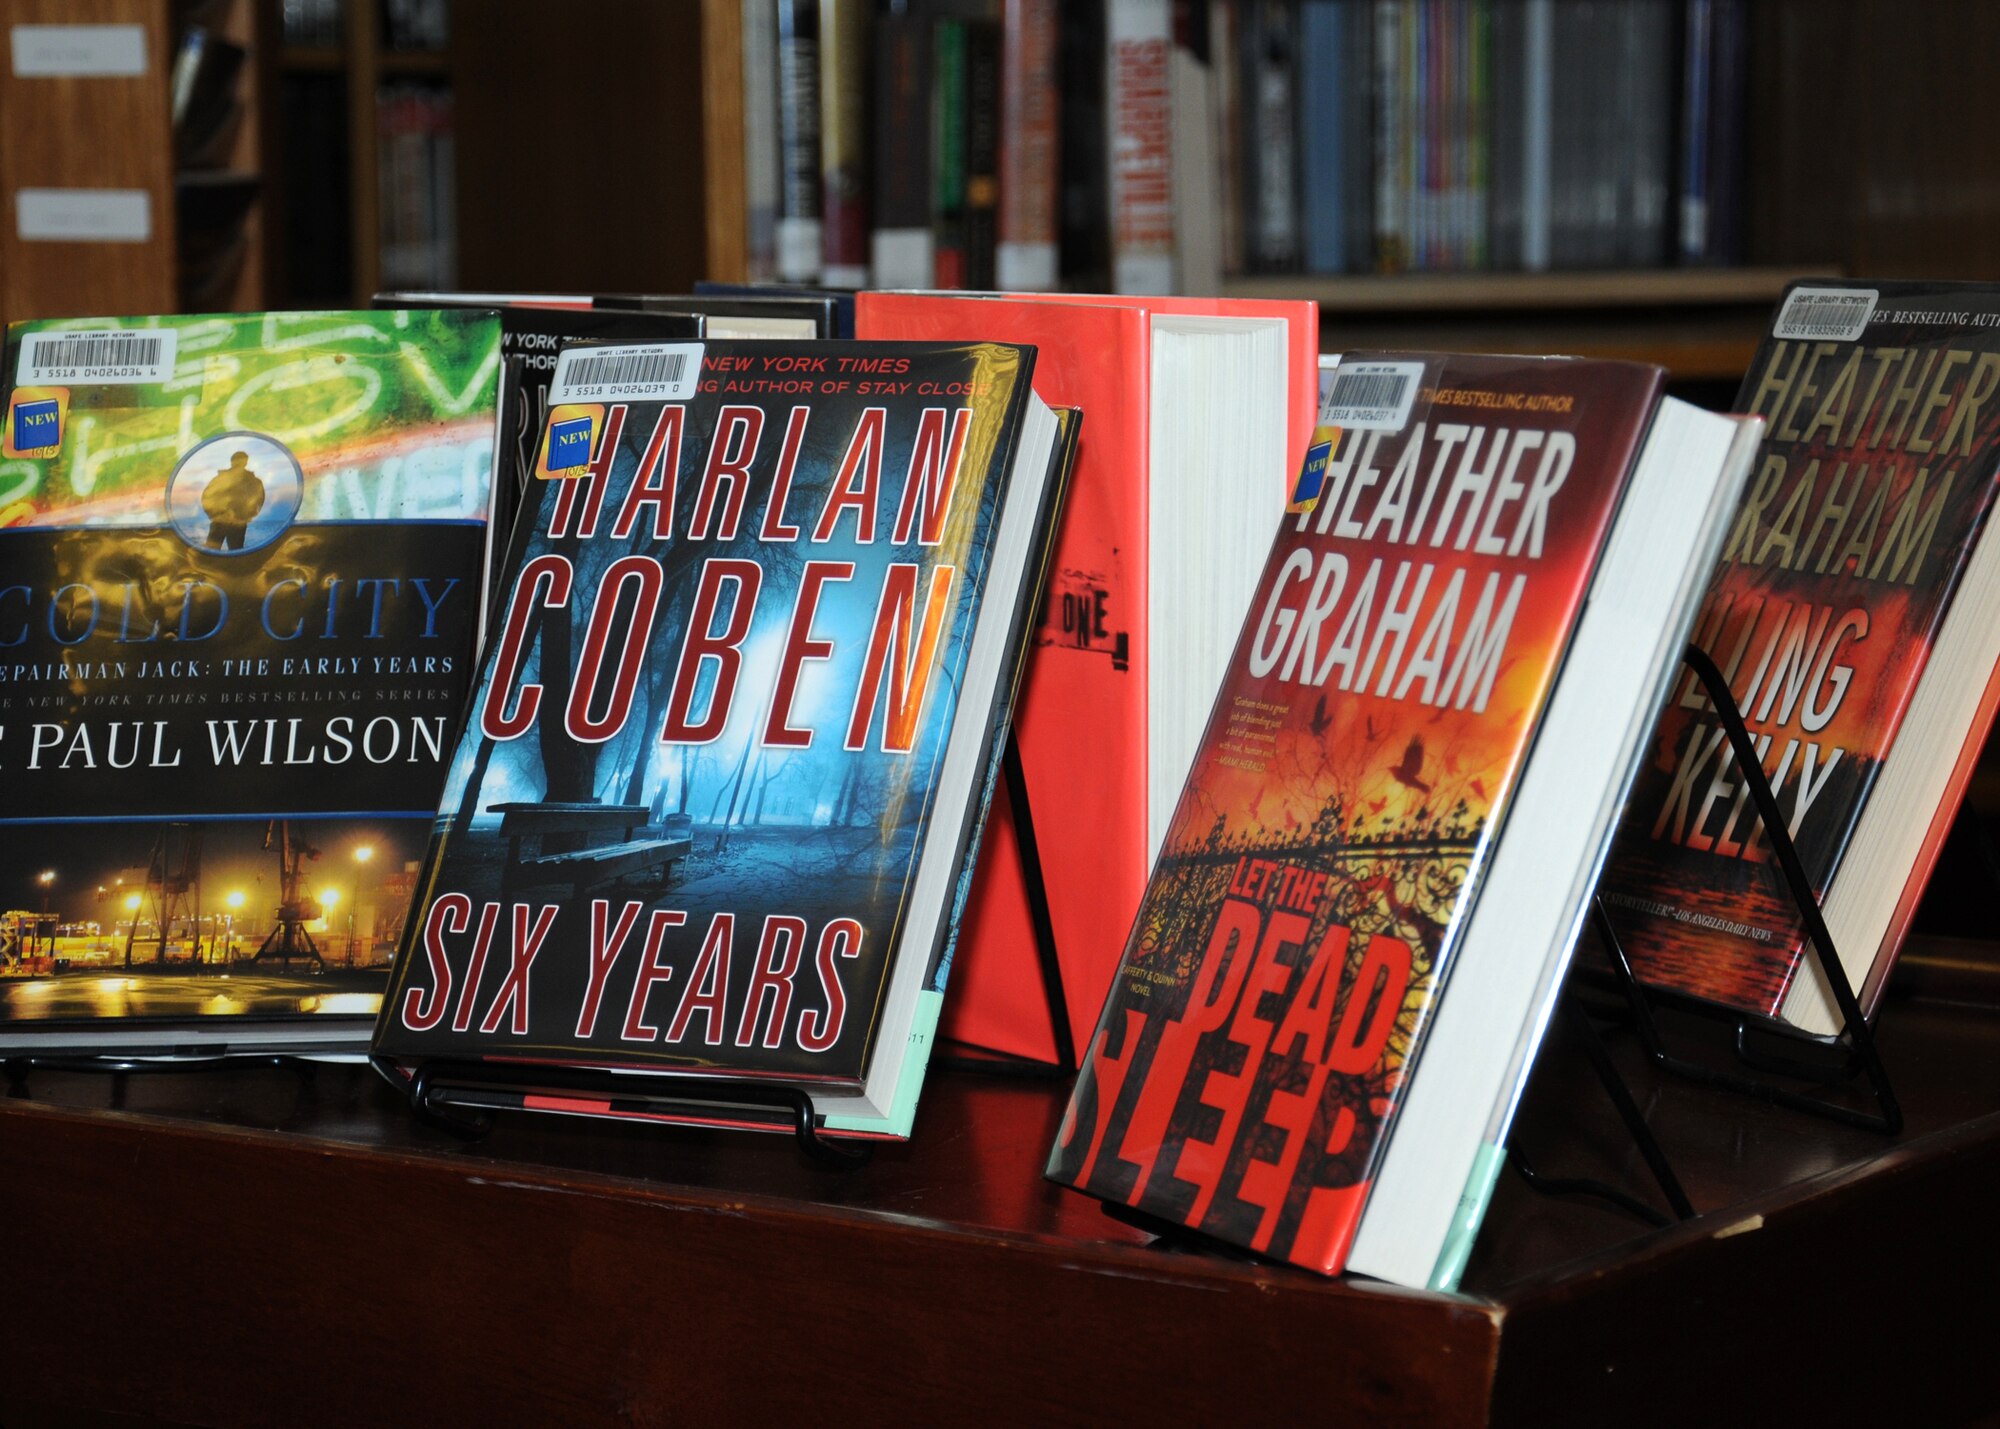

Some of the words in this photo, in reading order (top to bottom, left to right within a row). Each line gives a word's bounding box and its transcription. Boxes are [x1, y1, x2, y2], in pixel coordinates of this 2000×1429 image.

[1814, 295, 1840, 304] LIBRARY
[1840, 296, 1871, 305] NETWORK
[1892, 311, 1970, 326] BESTSELLING
[516, 333, 559, 350] YORK
[33, 369, 40, 378] 3
[47, 369, 77, 378] 5518
[84, 367, 142, 377] 04026036
[150, 367, 157, 377] 6
[701, 357, 753, 372] NEW
[762, 357, 829, 372] YORK
[837, 358, 911, 373] TIMES
[563, 387, 569, 396] 3
[576, 386, 603, 396] 5518
[609, 384, 665, 395] 04026039
[672, 384, 680, 394] 0
[724, 380, 817, 394] AUTHOR
[820, 381, 850, 394] OF
[856, 382, 912, 395] STAY
[917, 382, 990, 396] CLOSE
[1452, 389, 1522, 410] BESTSELLING
[1523, 393, 1575, 413] AUTHOR
[1748, 340, 2000, 457] HEATHER
[24, 411, 58, 428] NEW
[1331, 409, 1350, 421] 5518
[558, 430, 591, 447] NEW
[547, 403, 974, 546] HARLAN
[1295, 421, 1576, 559] HEATHER
[1722, 454, 1956, 586] RAHAM
[0, 581, 230, 648] COLD
[260, 577, 462, 642] CITY
[1063, 589, 1109, 648] ONE
[1248, 546, 1528, 714] GRAHAM
[480, 555, 956, 754] COBEN
[0, 662, 126, 682] EPAIRMAN
[137, 660, 211, 679] JACK:
[222, 659, 269, 676] THE
[282, 658, 362, 675] EARLY
[373, 656, 453, 673] YEARS
[27, 695, 68, 708] NEW
[82, 694, 134, 707] YORK
[146, 693, 208, 705] TIMES
[220, 690, 361, 703] BESTSELLING
[375, 689, 450, 701] SERIES
[26, 720, 182, 770] PAUL
[204, 716, 447, 767] WILSON
[1651, 723, 1846, 867] KELLY
[1228, 855, 1278, 902] LET
[1279, 867, 1330, 913] THE
[1689, 913, 1728, 932] ANGELES
[1725, 921, 1751, 936] DAILY
[1748, 927, 1773, 942] NEWS
[402, 892, 560, 1036] SIX
[573, 900, 864, 1053] YEARS
[1152, 973, 1176, 986] QUINN
[1130, 983, 1151, 997] NOVEL
[1188, 898, 1413, 1077] DEAD
